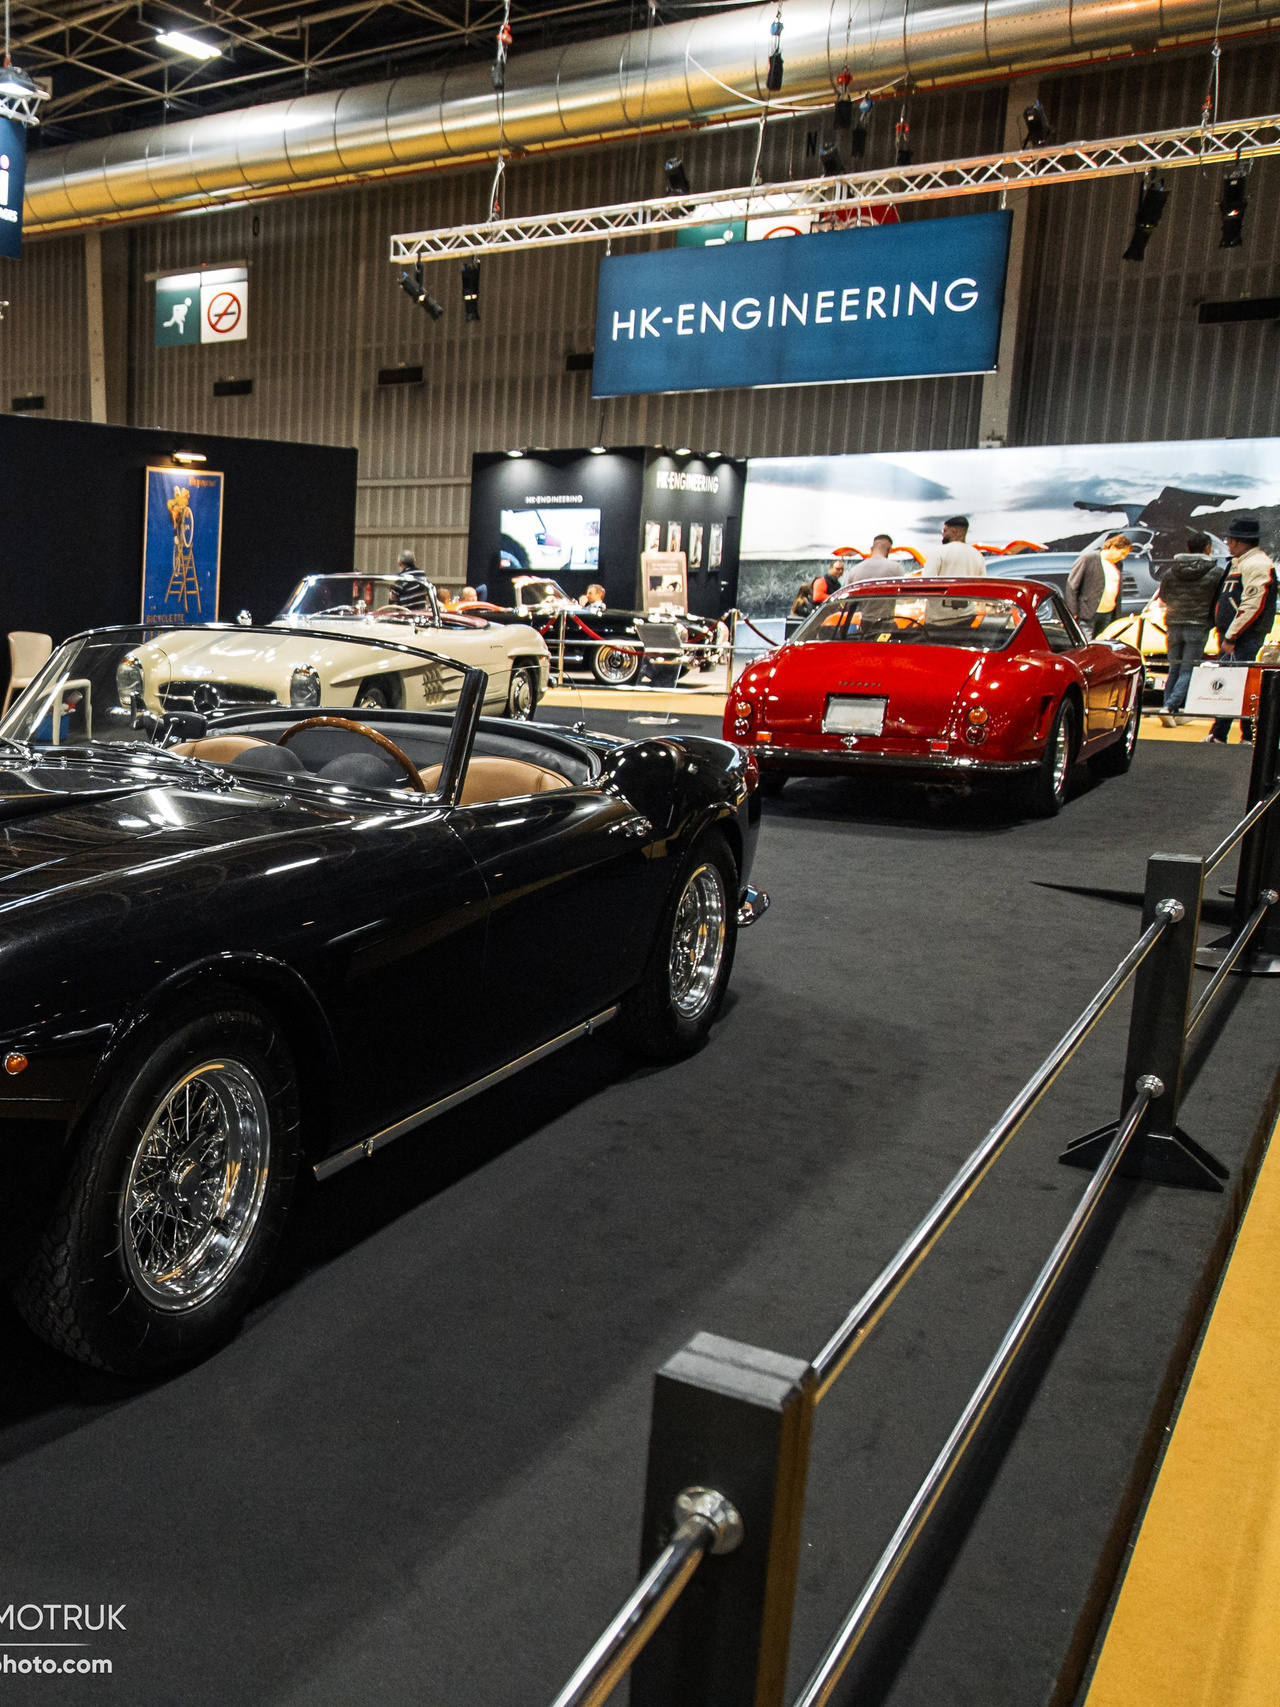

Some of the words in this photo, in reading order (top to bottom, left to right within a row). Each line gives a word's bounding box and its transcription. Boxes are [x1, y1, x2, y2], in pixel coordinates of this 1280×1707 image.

[611, 277, 979, 341] HK-ENGINEERING
[656, 470, 719, 493] HK-ENGINEERING
[525, 494, 584, 504] HK-ENGINEERING
